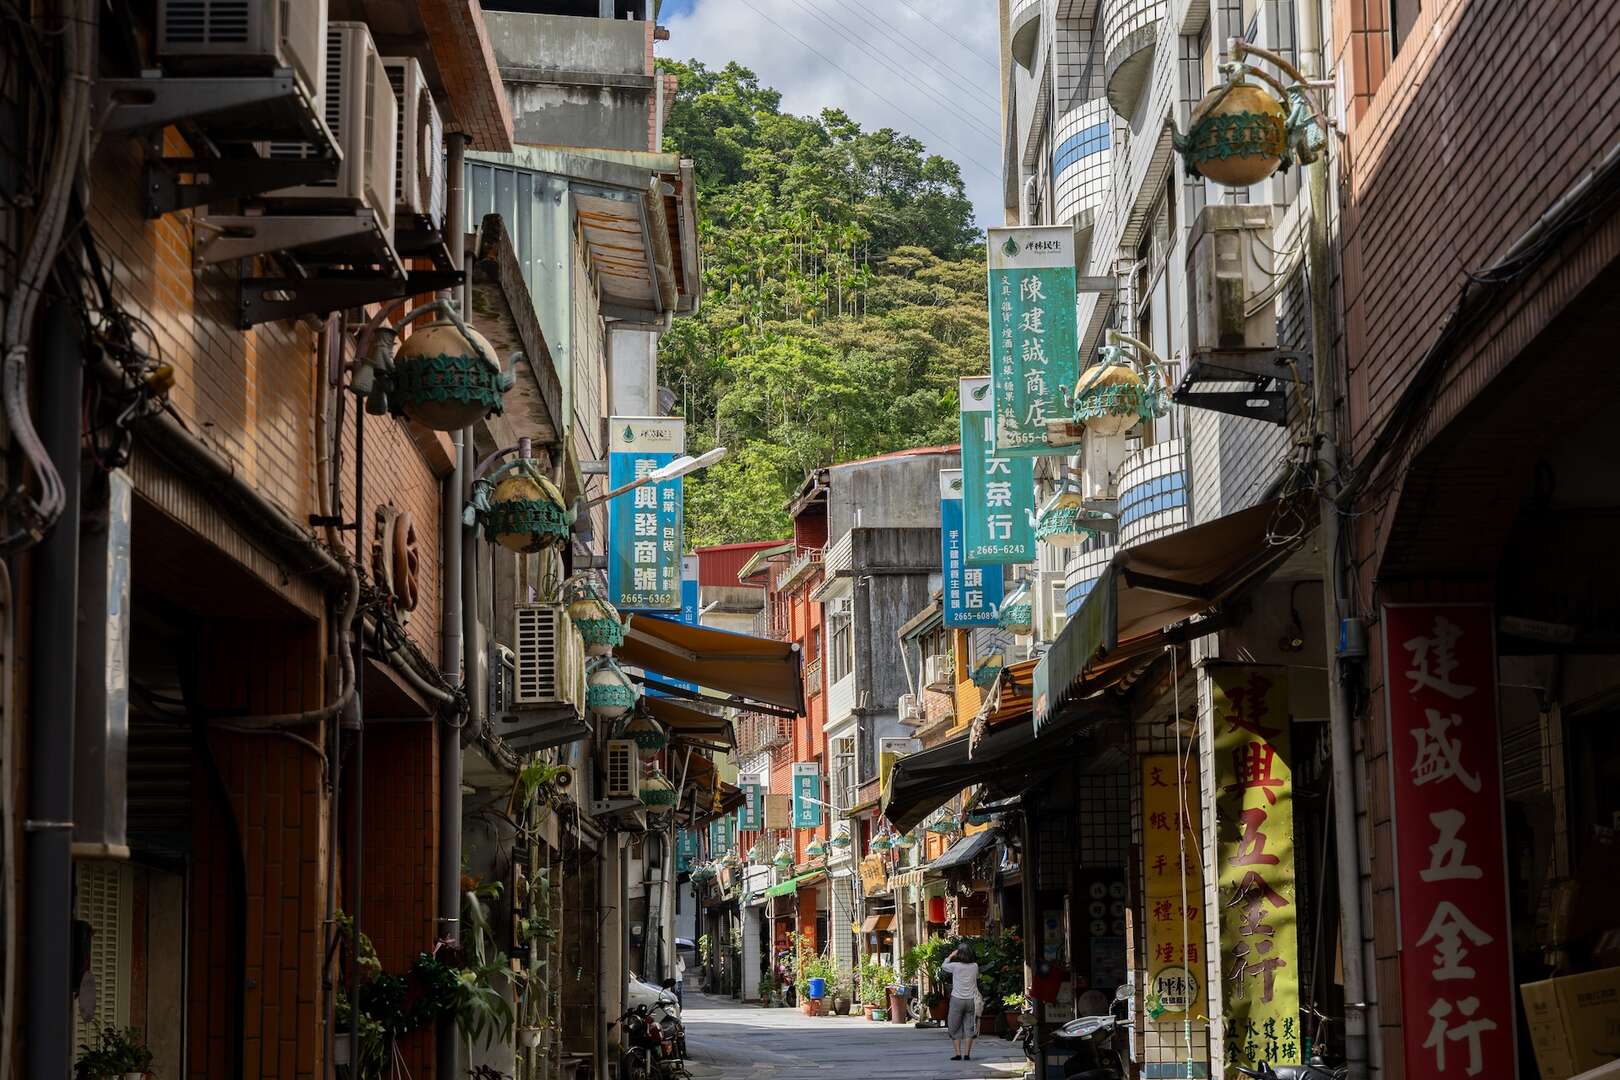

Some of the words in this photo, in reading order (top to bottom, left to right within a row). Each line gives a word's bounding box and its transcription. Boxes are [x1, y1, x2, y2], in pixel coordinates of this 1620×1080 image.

[1017, 275, 1048, 427] 陳建誠商店
[976, 544, 1025, 554] 2665-6243
[620, 593, 671, 604] 2665-6362
[1223, 671, 1290, 1003] 建興五金行
[1402, 615, 1498, 1077] 建盛五金行
[1152, 900, 1198, 921] 禮物
[1157, 976, 1194, 996] 坪林
[1227, 1019, 1241, 1063] 五金
[1245, 1019, 1260, 1063] 水電
[1263, 1017, 1279, 1063] 建材
